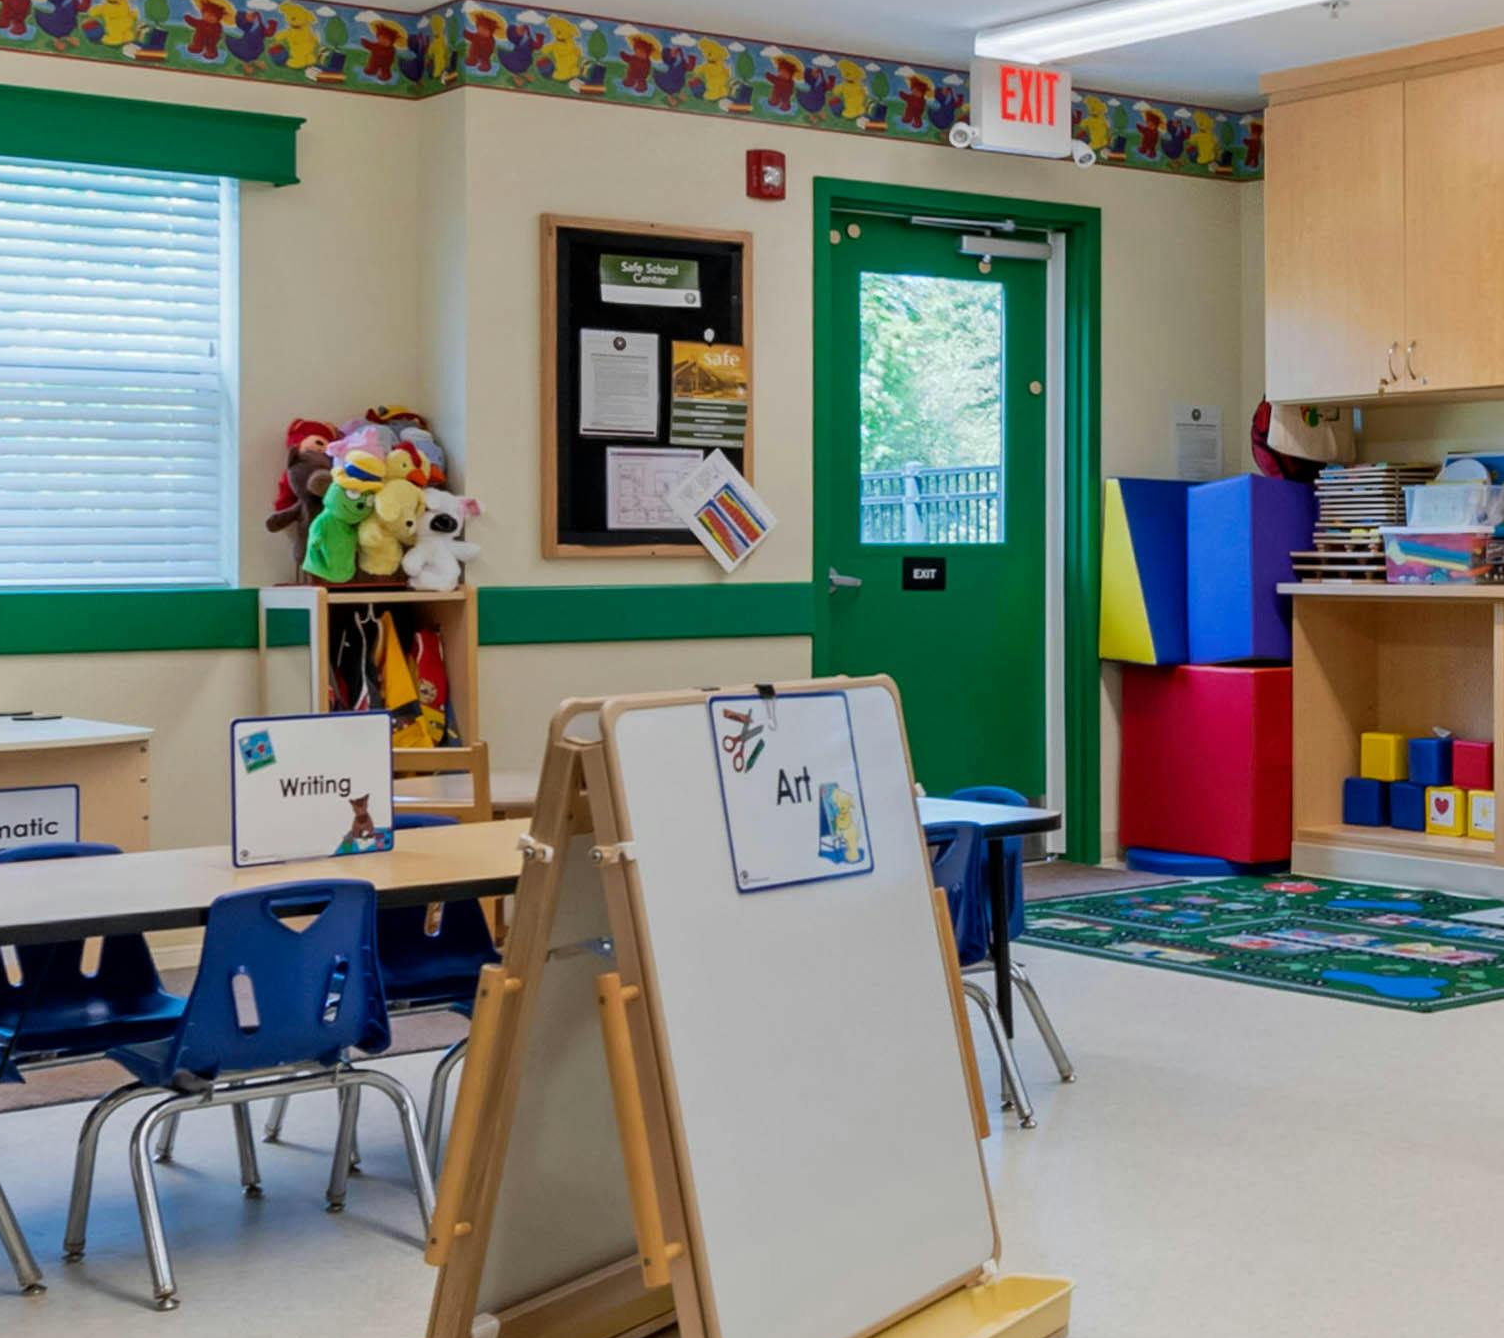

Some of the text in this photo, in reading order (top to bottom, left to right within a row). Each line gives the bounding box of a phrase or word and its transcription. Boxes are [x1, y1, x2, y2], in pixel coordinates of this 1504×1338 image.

[1000, 66, 1060, 127] EXIT
[621, 261, 679, 276] Safe School
[633, 273, 667, 286] Center
[704, 350, 740, 367] safe
[913, 568, 937, 579] EXIT
[280, 775, 351, 797] Writing
[776, 766, 813, 805] Art
